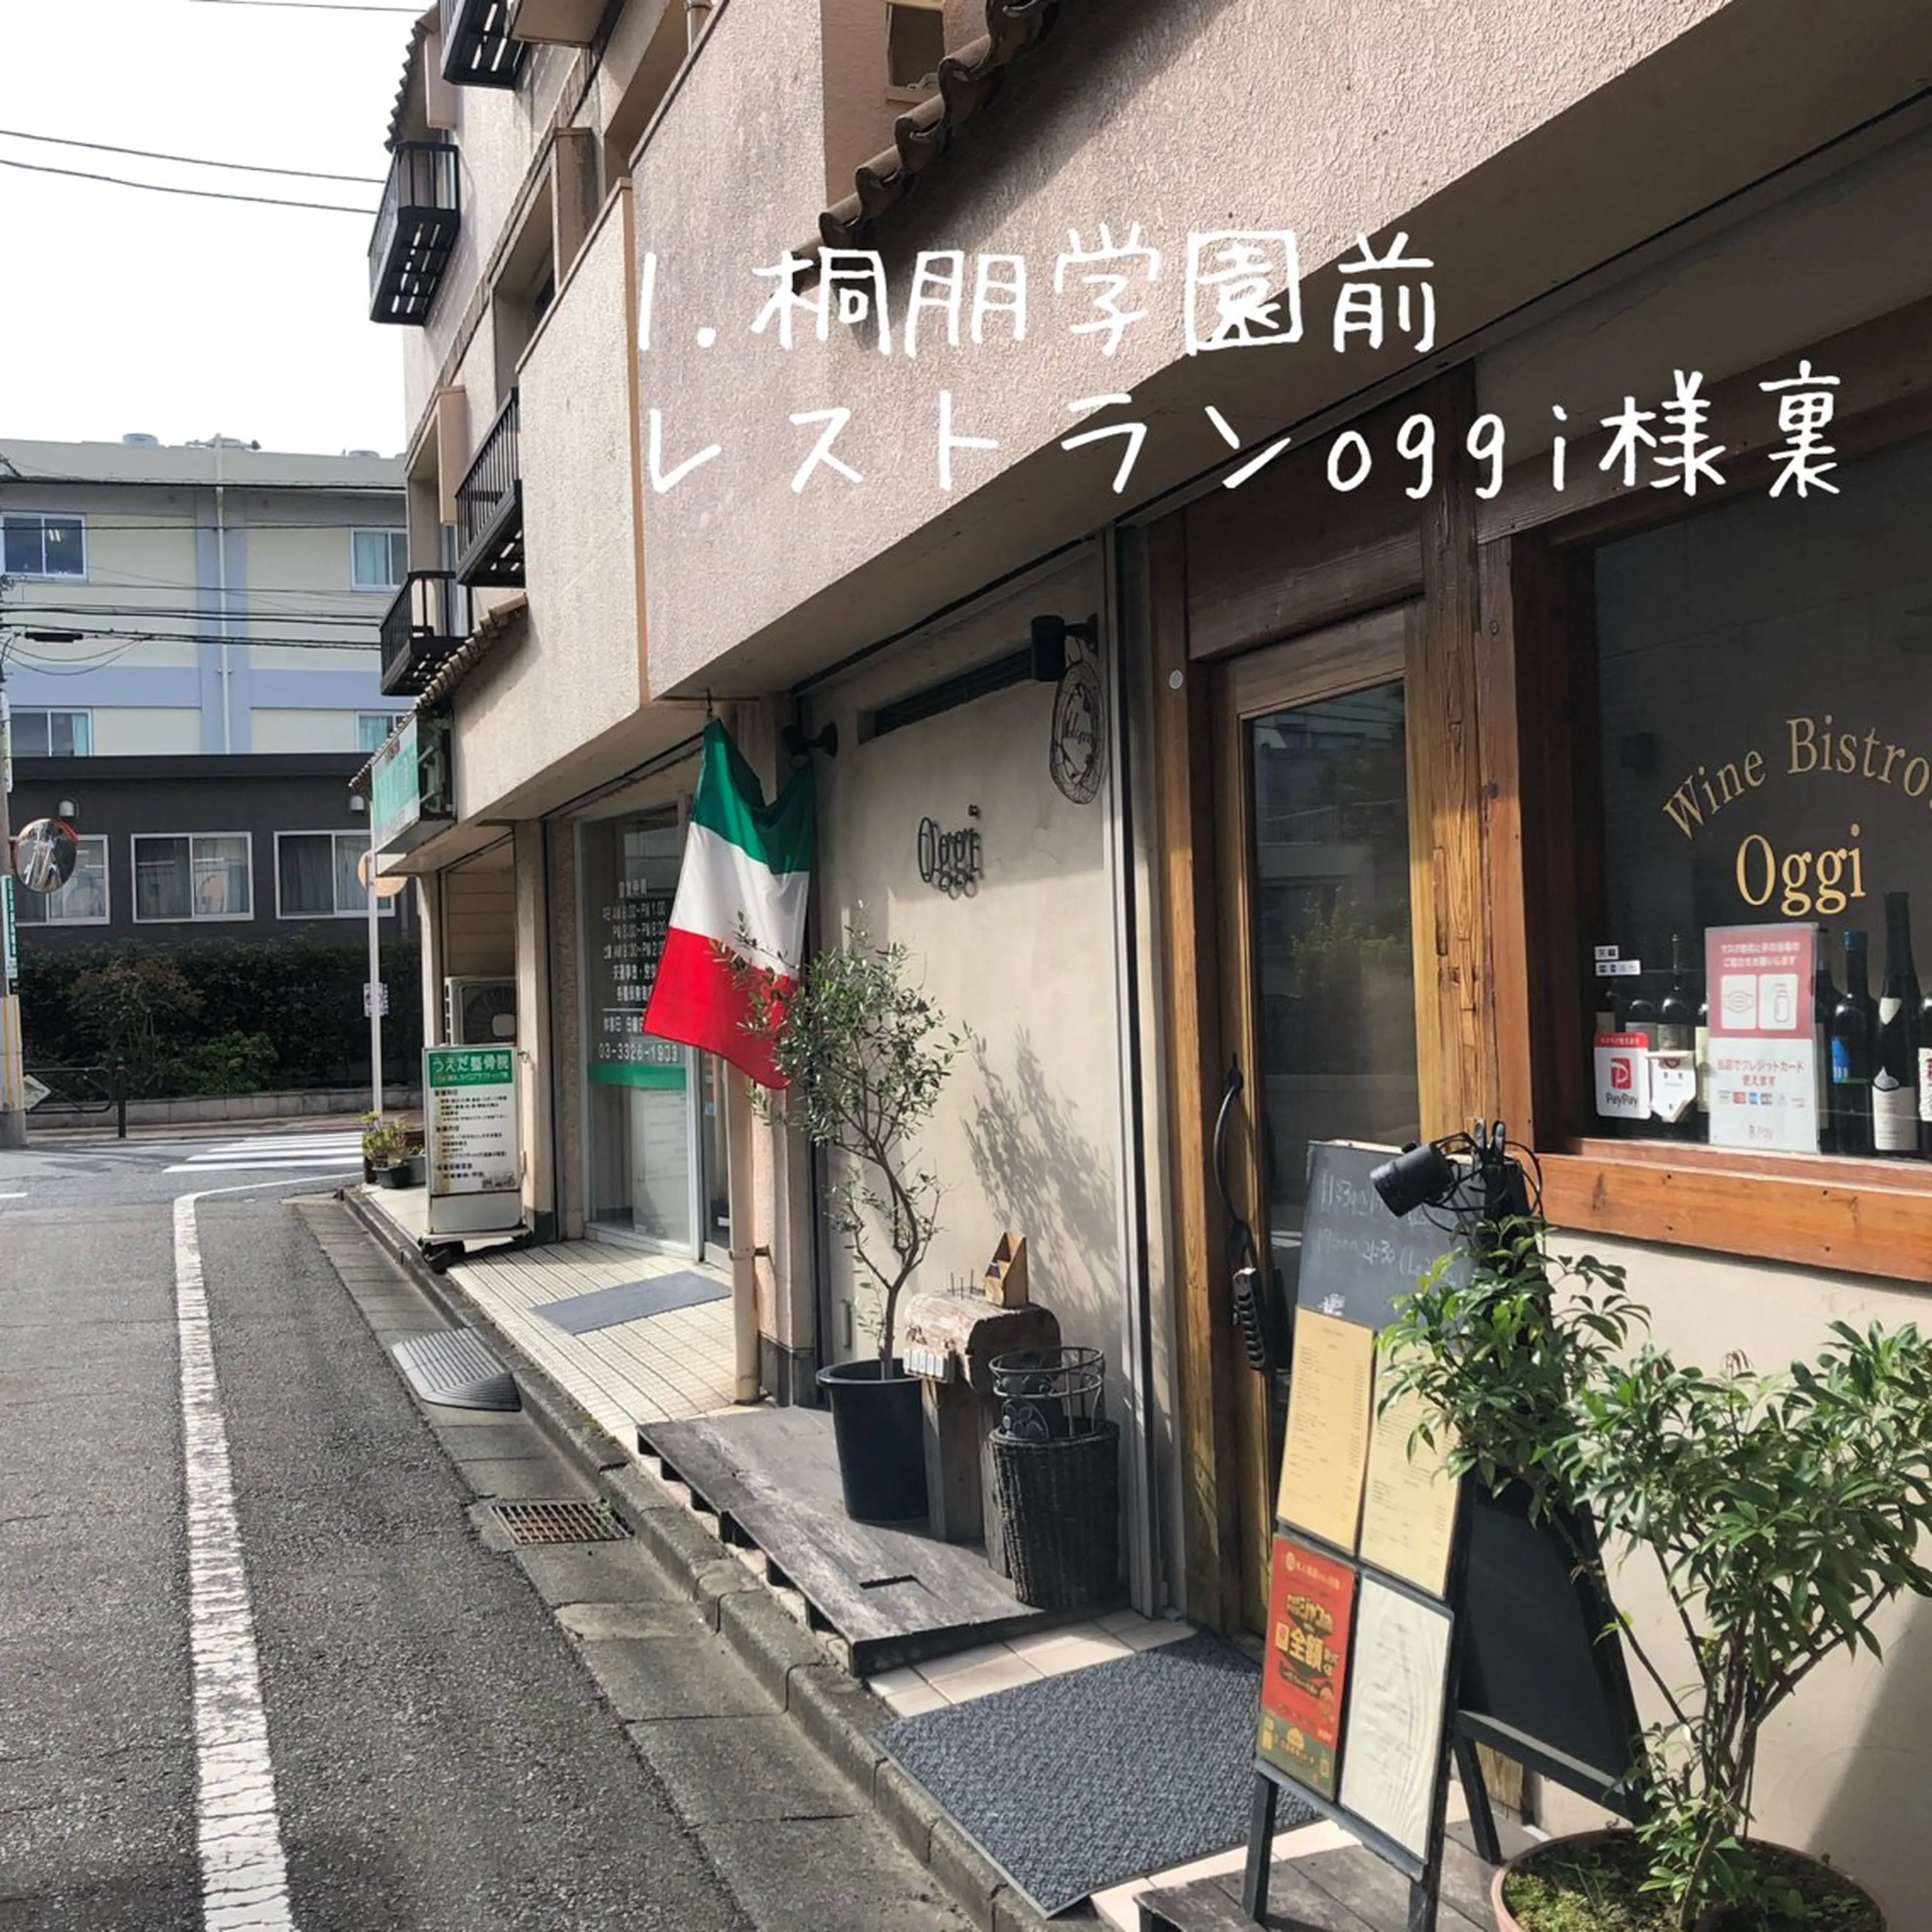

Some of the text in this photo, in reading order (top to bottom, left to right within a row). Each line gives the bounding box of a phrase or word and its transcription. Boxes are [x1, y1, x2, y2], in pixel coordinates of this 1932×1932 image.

[1662, 714, 1930, 839] Wine Bistro
[1736, 823, 1866, 916] Oggi
[1605, 1092, 1638, 1107] PayPay
